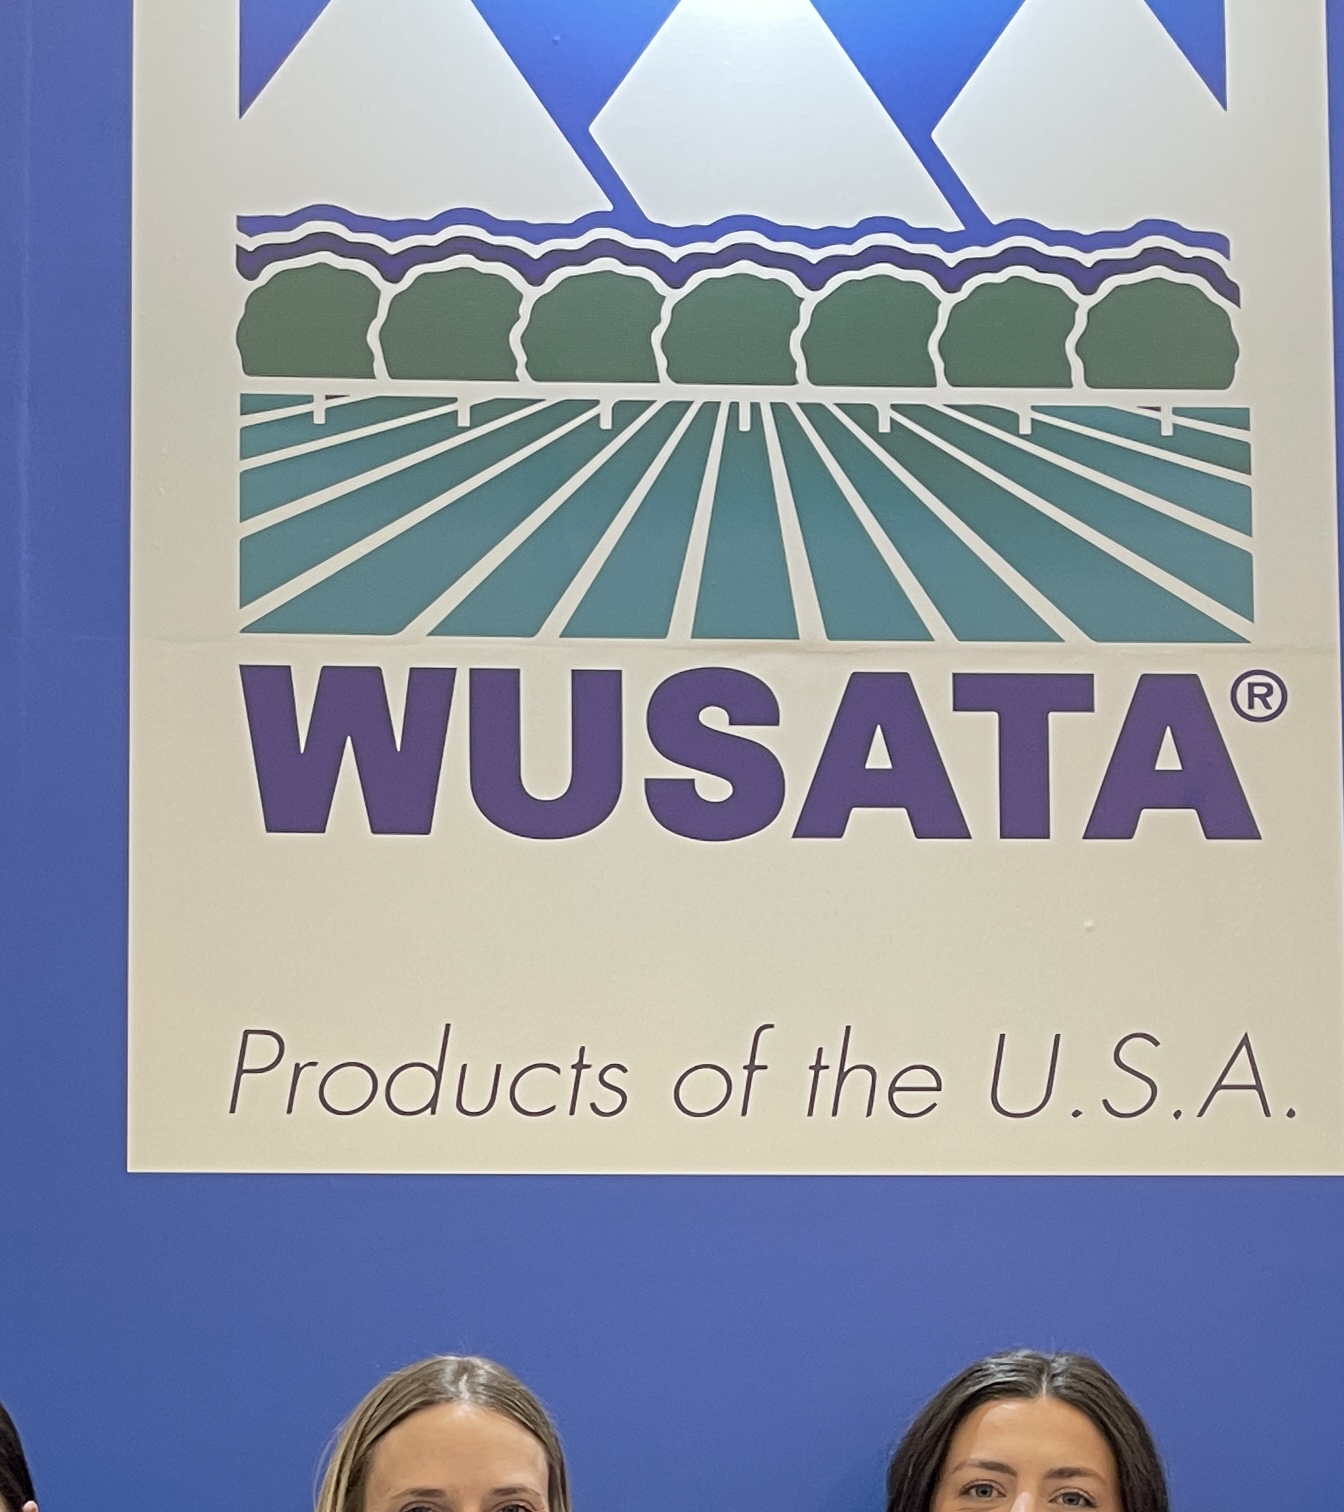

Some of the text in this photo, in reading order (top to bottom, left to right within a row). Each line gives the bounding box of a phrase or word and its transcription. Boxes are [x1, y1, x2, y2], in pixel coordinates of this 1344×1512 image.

[228, 1022, 1297, 1121] Products of the U.S.A.
